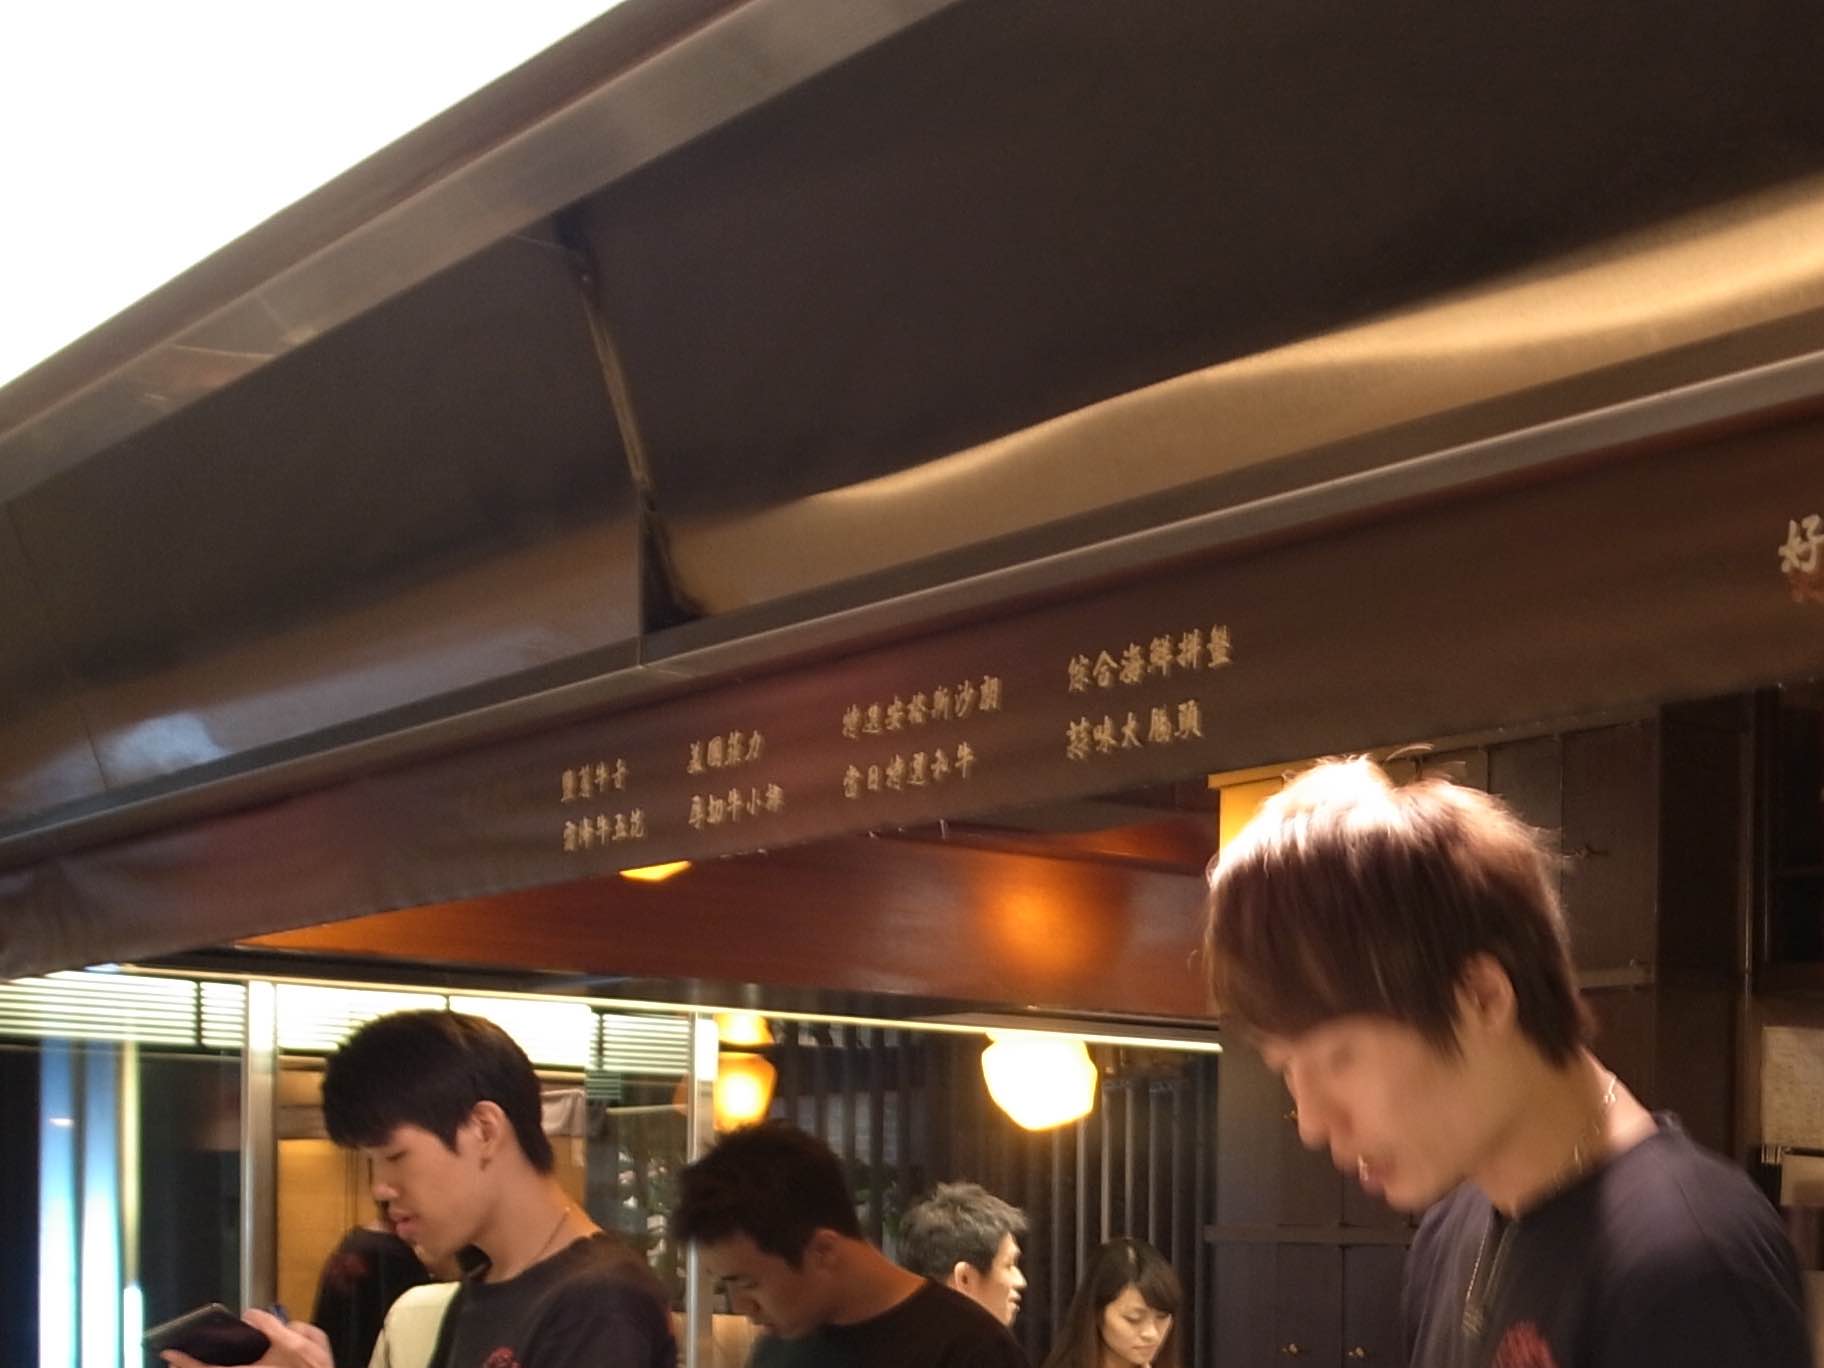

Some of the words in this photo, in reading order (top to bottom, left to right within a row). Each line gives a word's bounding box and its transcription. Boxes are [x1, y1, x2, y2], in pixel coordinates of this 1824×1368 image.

[842, 741, 976, 798] 當日特選和牛
